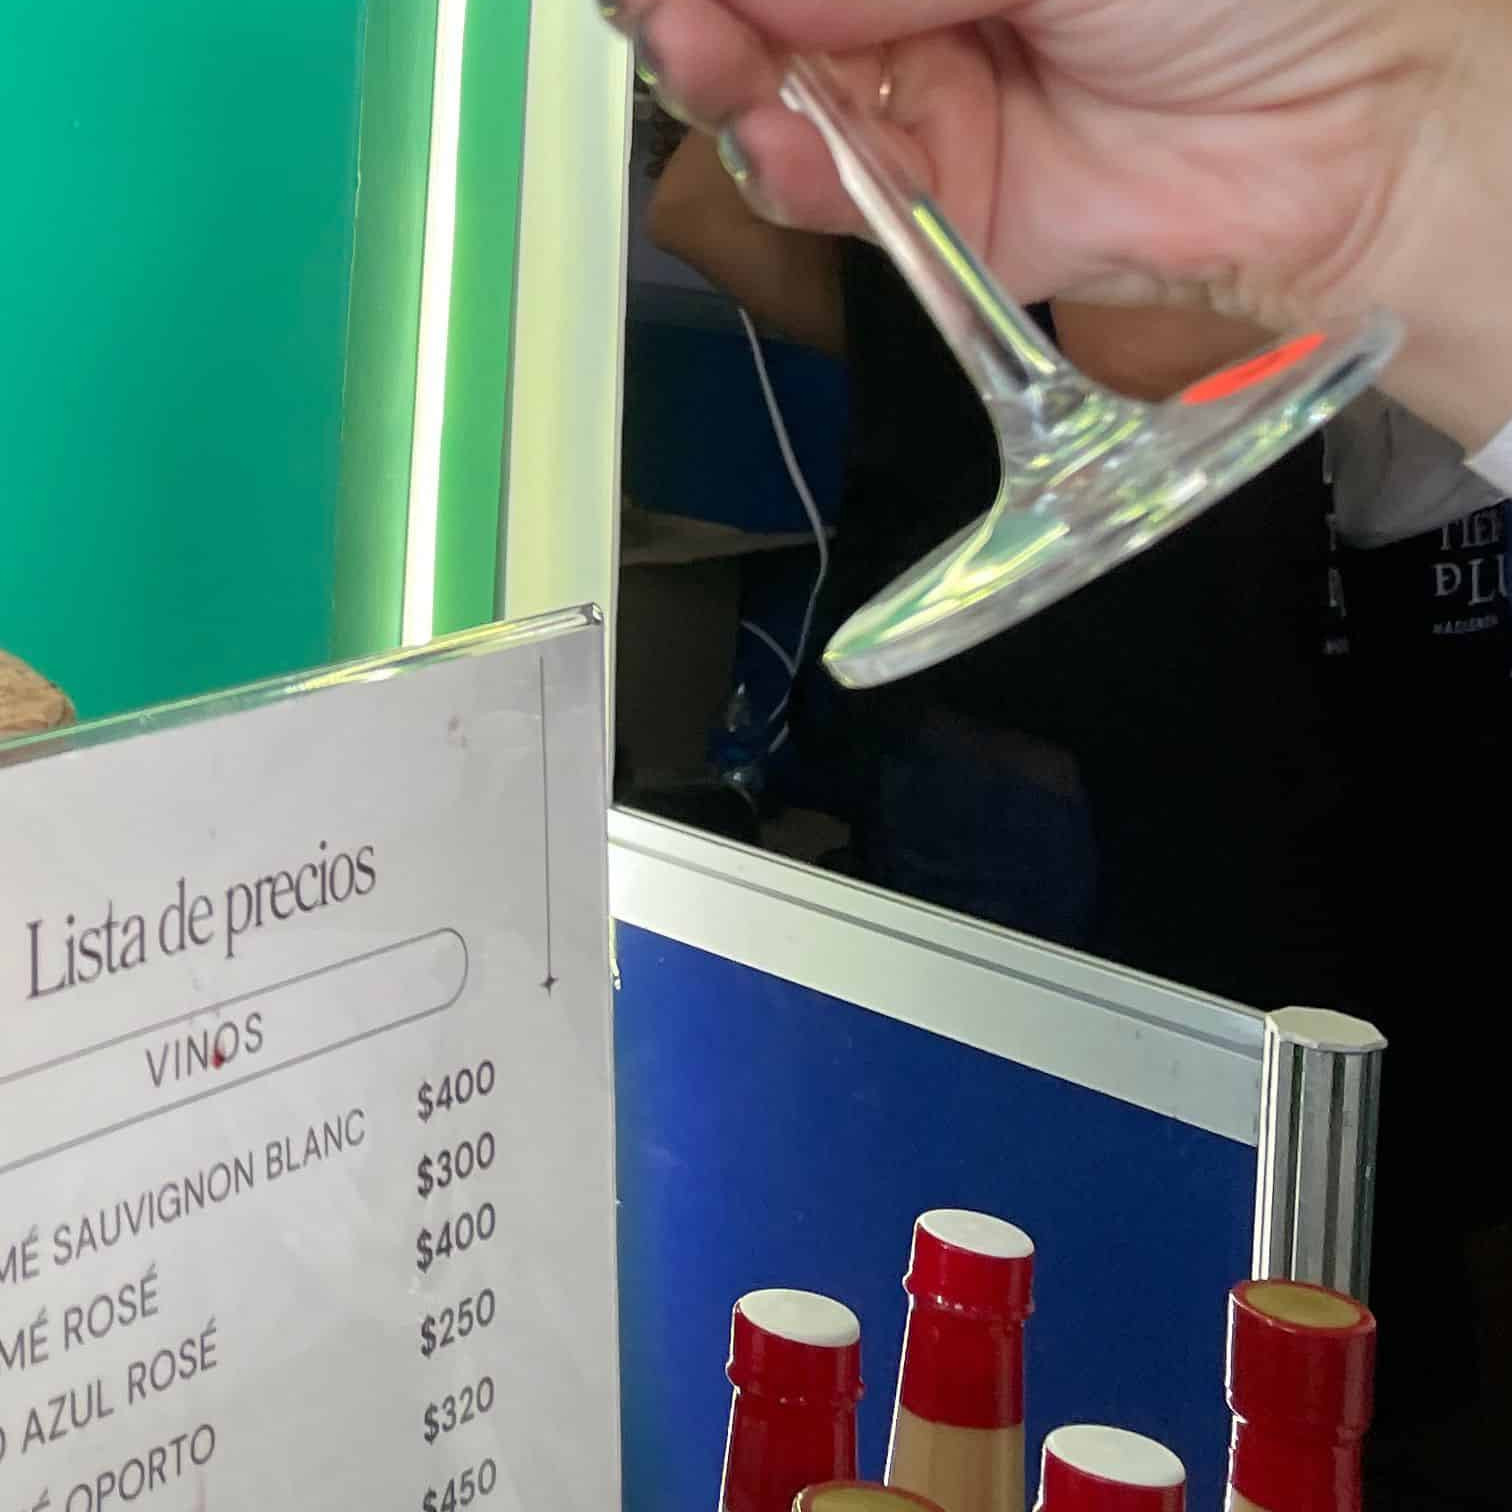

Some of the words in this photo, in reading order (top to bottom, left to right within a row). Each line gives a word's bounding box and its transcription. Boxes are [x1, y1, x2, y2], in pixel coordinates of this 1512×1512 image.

[25, 898, 148, 1000] Lista
[158, 875, 215, 956] de
[224, 840, 377, 960] precios
[144, 1011, 264, 1089] VINOS
[416, 1059, 496, 1124] $400
[52, 1150, 255, 1266] SAUVIGNON
[265, 1108, 367, 1181] BLANC
[416, 1131, 496, 1201] $300
[416, 1201, 497, 1275] $400
[62, 1258, 160, 1352] ROSÉ
[420, 1287, 497, 1361] $250
[20, 1379, 116, 1455] AZUL
[126, 1317, 218, 1406] ROSÉ
[423, 1375, 495, 1447] $320
[65, 1422, 217, 1512] OPORTO
[422, 1457, 497, 1512] $450
